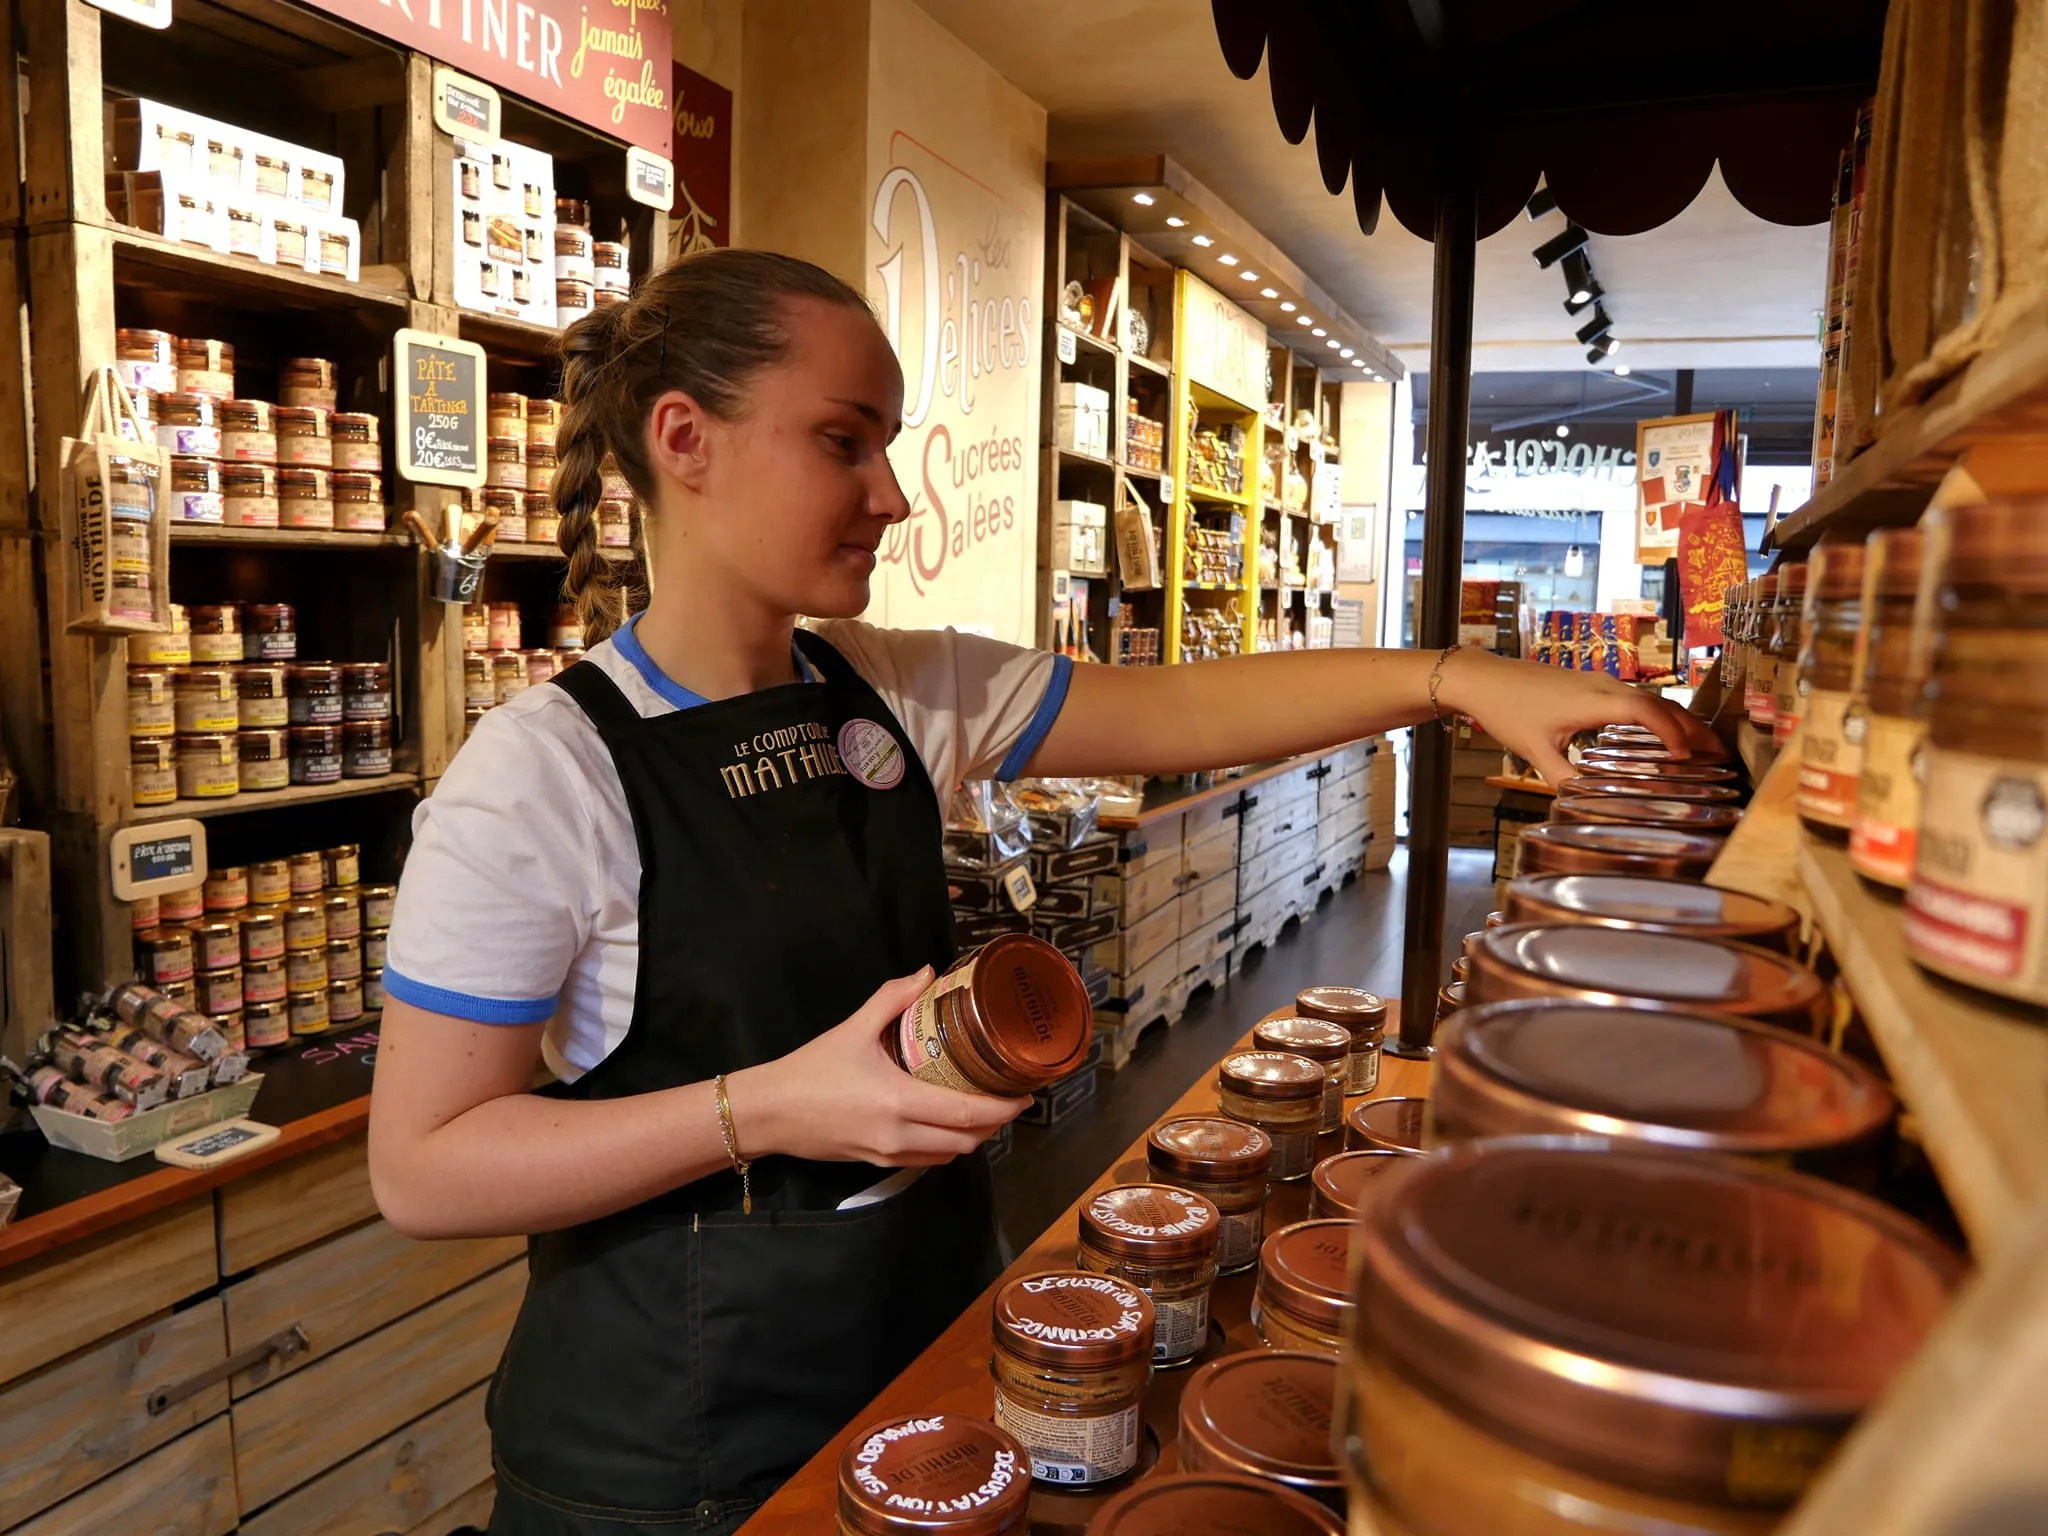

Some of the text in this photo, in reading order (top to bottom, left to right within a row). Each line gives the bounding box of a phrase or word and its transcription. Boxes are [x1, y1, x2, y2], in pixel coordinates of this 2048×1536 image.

[378, 0, 564, 90] INER
[570, 5, 643, 79] jamais
[603, 60, 667, 125] égalée.
[871, 165, 1032, 430] Délices
[415, 353, 456, 382] PÂTE
[86, 476, 105, 603] MATHILDE
[720, 742, 848, 799] MATHILDE
[734, 741, 751, 757] LE
[753, 722, 821, 753] COMPTOIR
[1013, 965, 1053, 1044] MATHILDE
